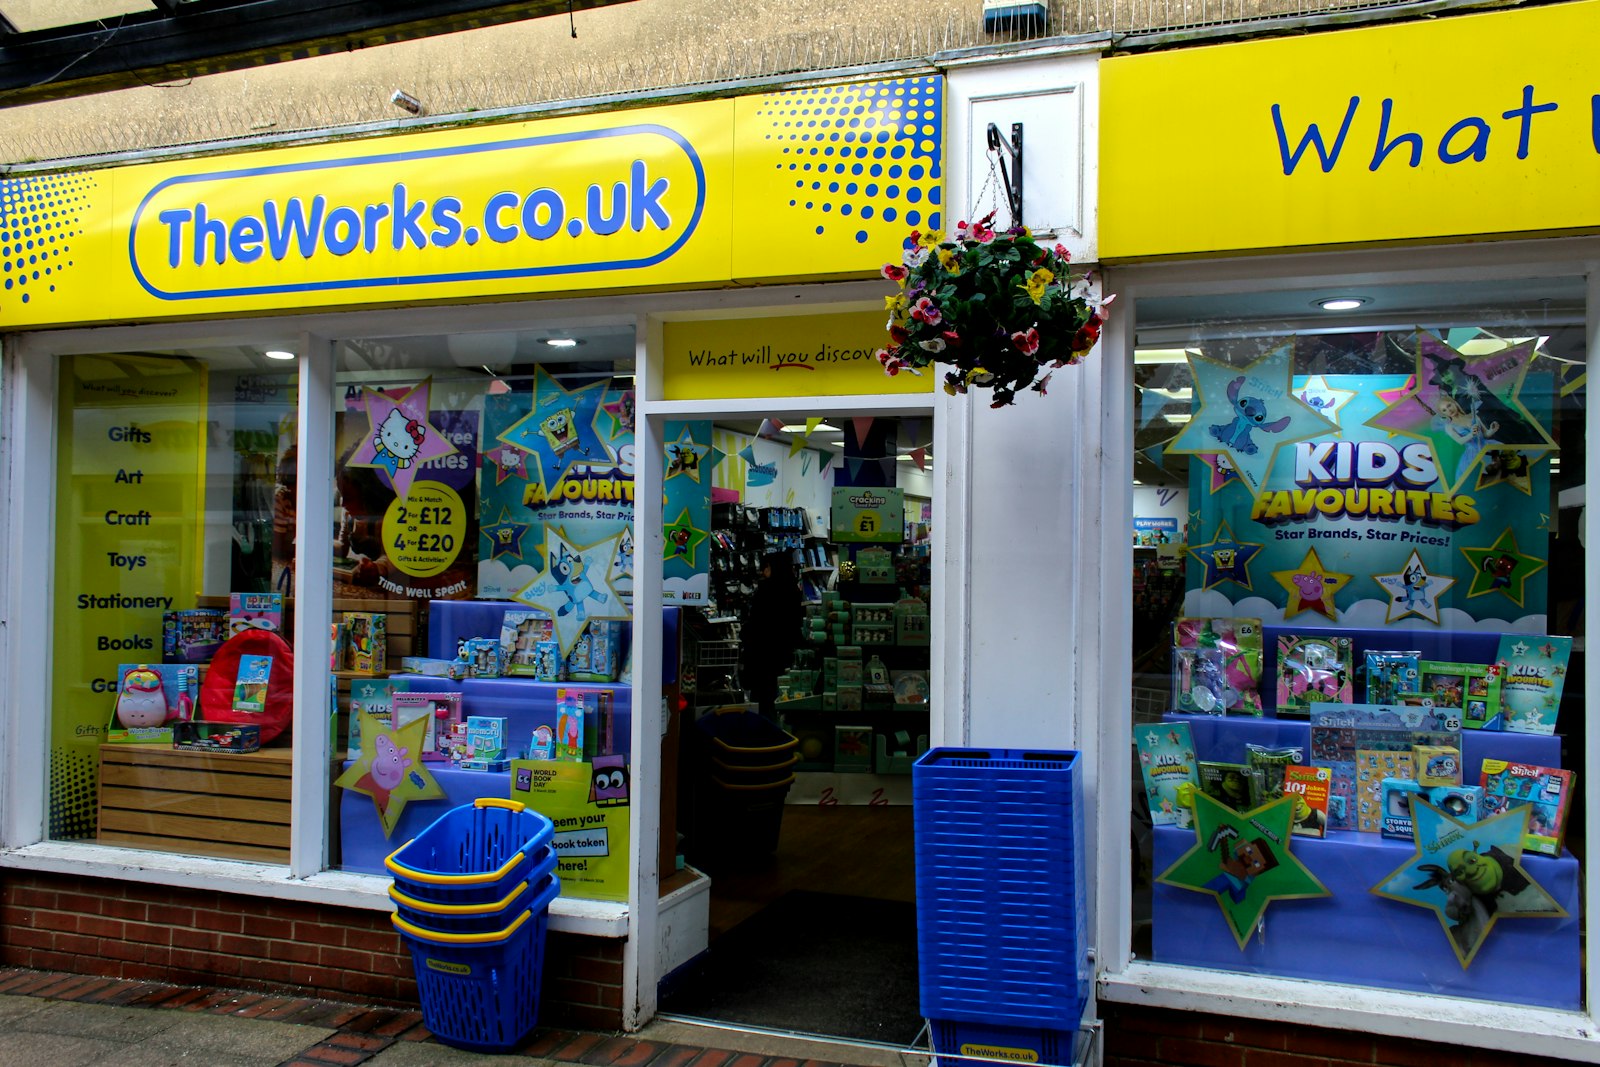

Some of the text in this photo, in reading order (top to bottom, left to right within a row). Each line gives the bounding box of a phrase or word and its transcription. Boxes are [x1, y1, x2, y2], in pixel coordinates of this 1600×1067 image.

[1271, 85, 1558, 176] What
[159, 159, 671, 270] TheWorks.co.uk
[689, 350, 738, 367] What
[742, 346, 771, 365] will
[777, 352, 809, 371] you
[82, 383, 105, 392] What
[139, 387, 178, 397] discover?
[108, 426, 152, 443] Gifts
[1294, 441, 1440, 487] KIDS
[114, 468, 144, 484] Art
[849, 496, 886, 504] Cracking
[1251, 487, 1481, 526] FAVOURITES
[105, 510, 152, 526] Craft
[397, 506, 407, 524] 2
[420, 507, 452, 525] £12
[538, 512, 557, 521] Star
[559, 511, 594, 520] Brands,
[596, 511, 615, 520] Star
[860, 520, 875, 532] £1
[394, 533, 406, 551] 4
[417, 534, 454, 552] £20
[1275, 528, 1450, 548] Star Brands, Star Prices!
[107, 552, 147, 571] Toys
[378, 575, 467, 598] Time well spent
[77, 593, 173, 611] Stationery
[1241, 627, 1252, 635] £6
[98, 635, 153, 651] Books
[1430, 663, 1466, 674] Ravensburger
[1466, 666, 1483, 674] Puzzle
[1512, 664, 1547, 677] KIDS
[365, 702, 393, 714] KIDS
[75, 724, 100, 736] Gifts
[1446, 720, 1459, 728] £5
[468, 729, 499, 739] memory
[1155, 754, 1181, 765] KIDS
[533, 769, 557, 777] WORLD
[1284, 781, 1307, 795] 101
[549, 814, 606, 828] eem your
[551, 838, 605, 849] book token
[557, 860, 588, 871] here!
[965, 1047, 1034, 1062] TheWorks.co.uk
